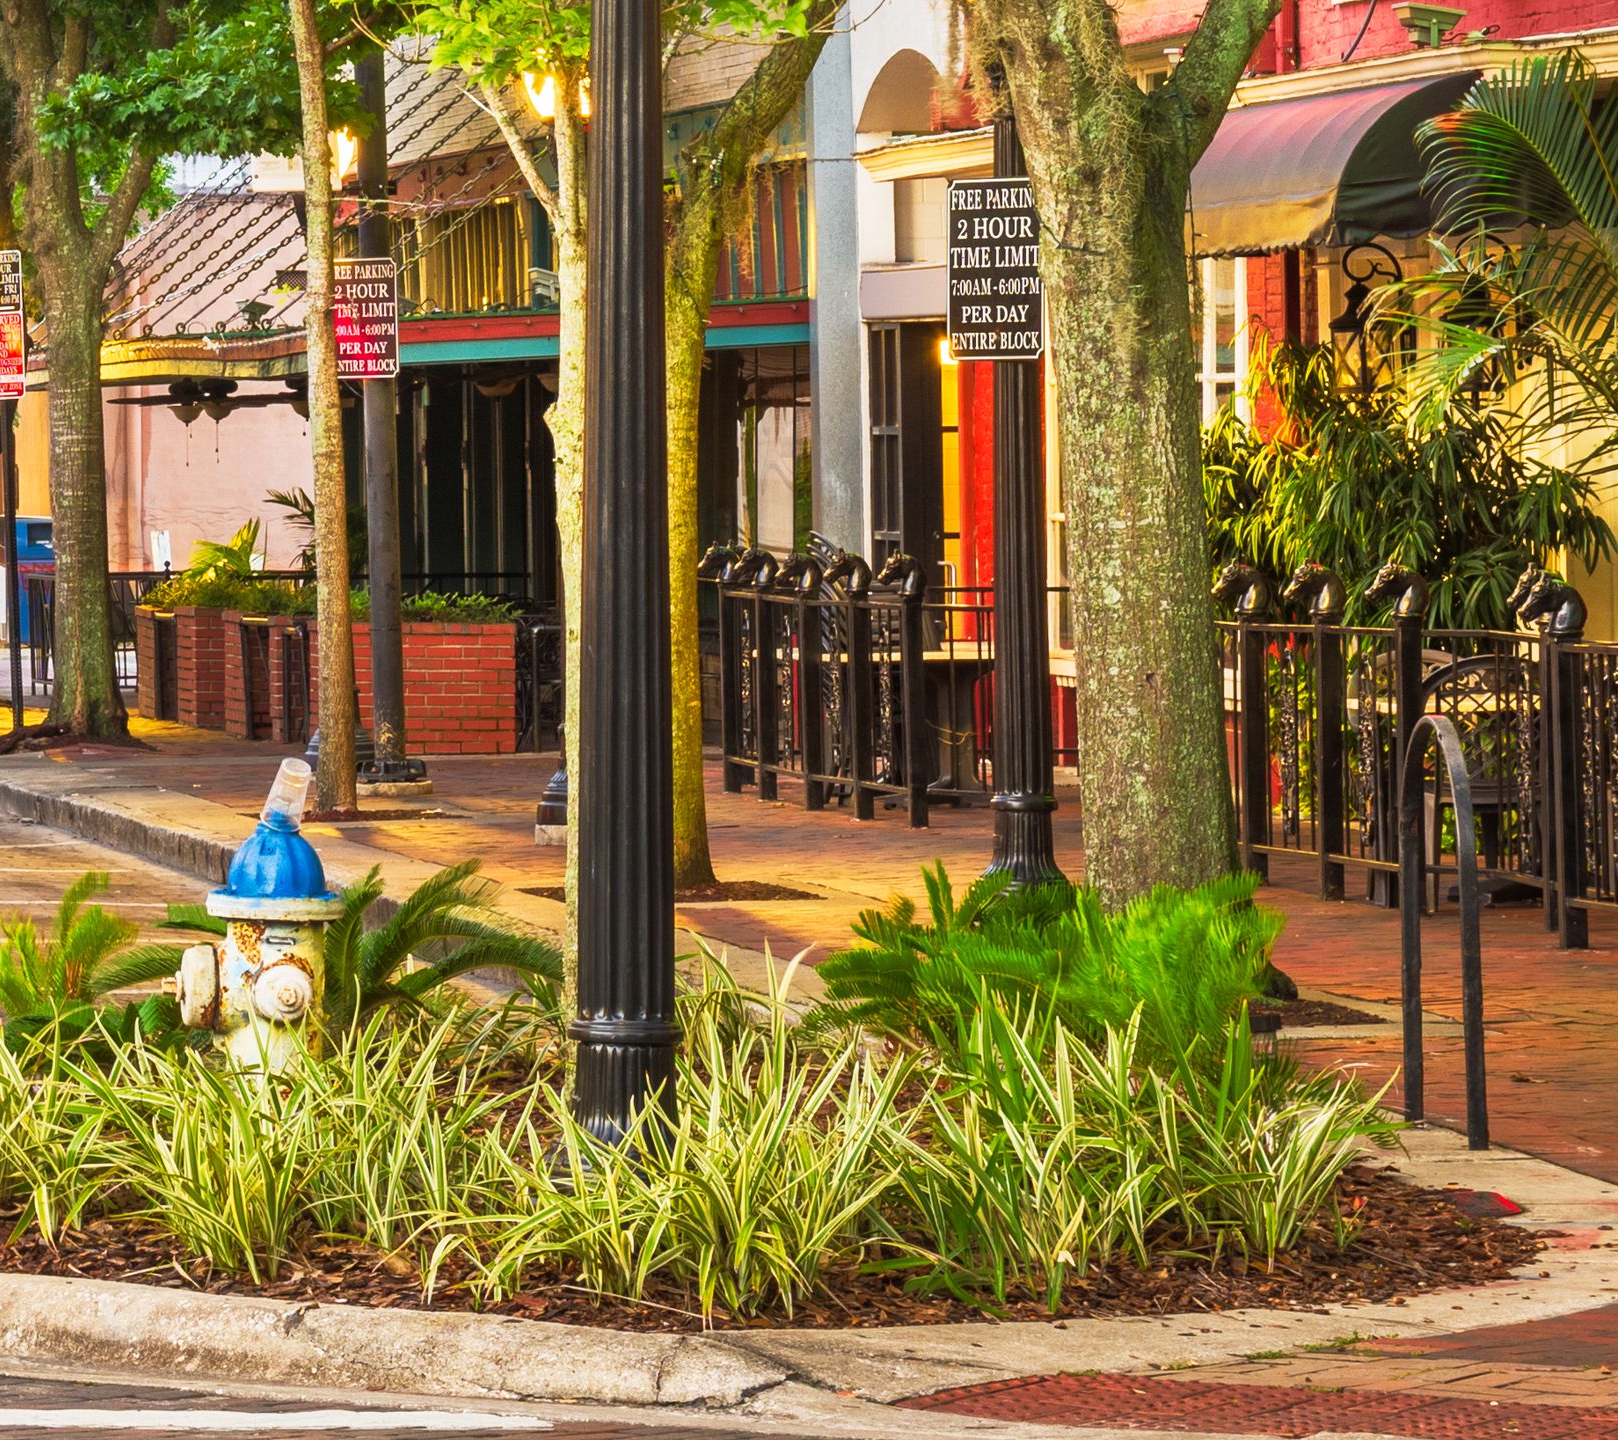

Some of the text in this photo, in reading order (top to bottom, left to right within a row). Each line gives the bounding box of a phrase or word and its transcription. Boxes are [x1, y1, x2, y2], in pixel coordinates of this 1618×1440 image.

[951, 187, 1037, 210] FREE PARKIN
[957, 217, 1033, 239] 2 HOUR
[951, 245, 1040, 268] TIME LIMIT
[334, 264, 393, 280] REE PARKING
[4, 284, 17, 294] FRI
[335, 283, 389, 299] 2 HOUR
[951, 278, 992, 296] 7:00AM
[999, 277, 1039, 294] 6:00PM
[362, 302, 394, 317] LIMIT
[961, 305, 1029, 323] PER DAY
[336, 324, 360, 336] :00AM
[365, 323, 394, 335] 6:00PM
[339, 341, 388, 354] PER DAY
[952, 331, 1039, 350] ENTIRE BLOCK
[337, 359, 396, 371] NTIRE BLOCK
